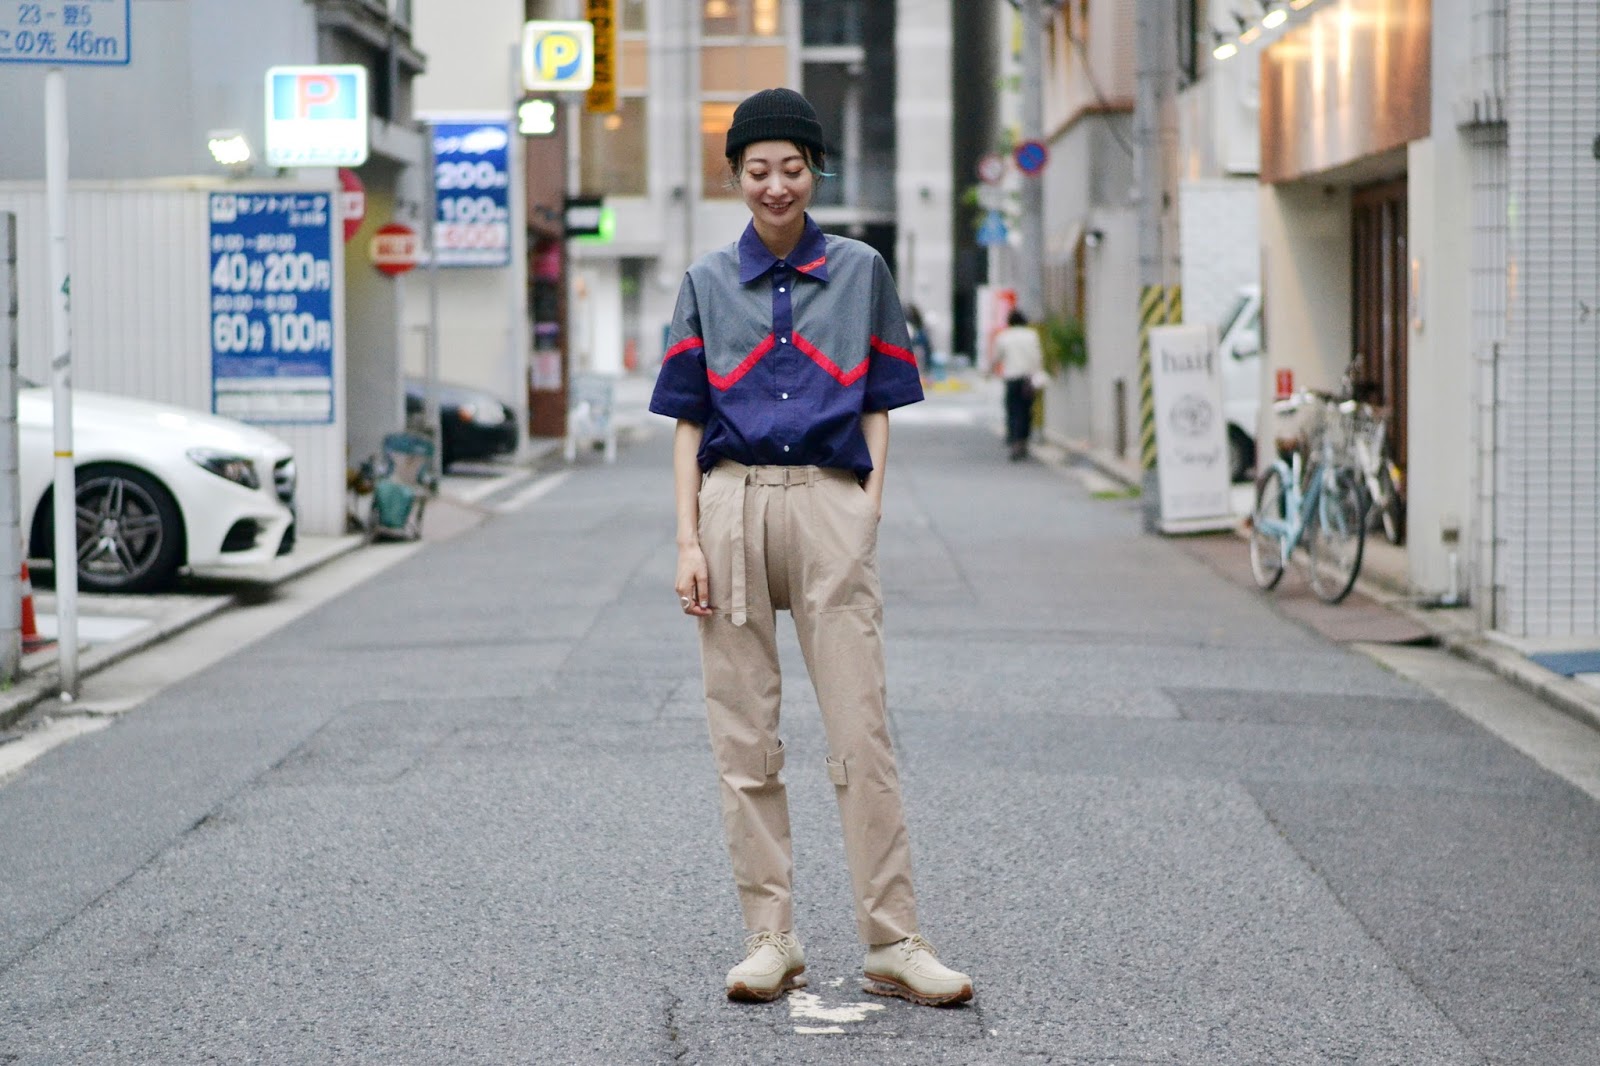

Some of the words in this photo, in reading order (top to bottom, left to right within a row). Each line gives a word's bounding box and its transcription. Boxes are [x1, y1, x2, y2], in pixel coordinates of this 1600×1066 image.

[0, 30, 57, 54] この先
[66, 30, 117, 55] 46m
[542, 34, 577, 79] P
[297, 75, 340, 118] P
